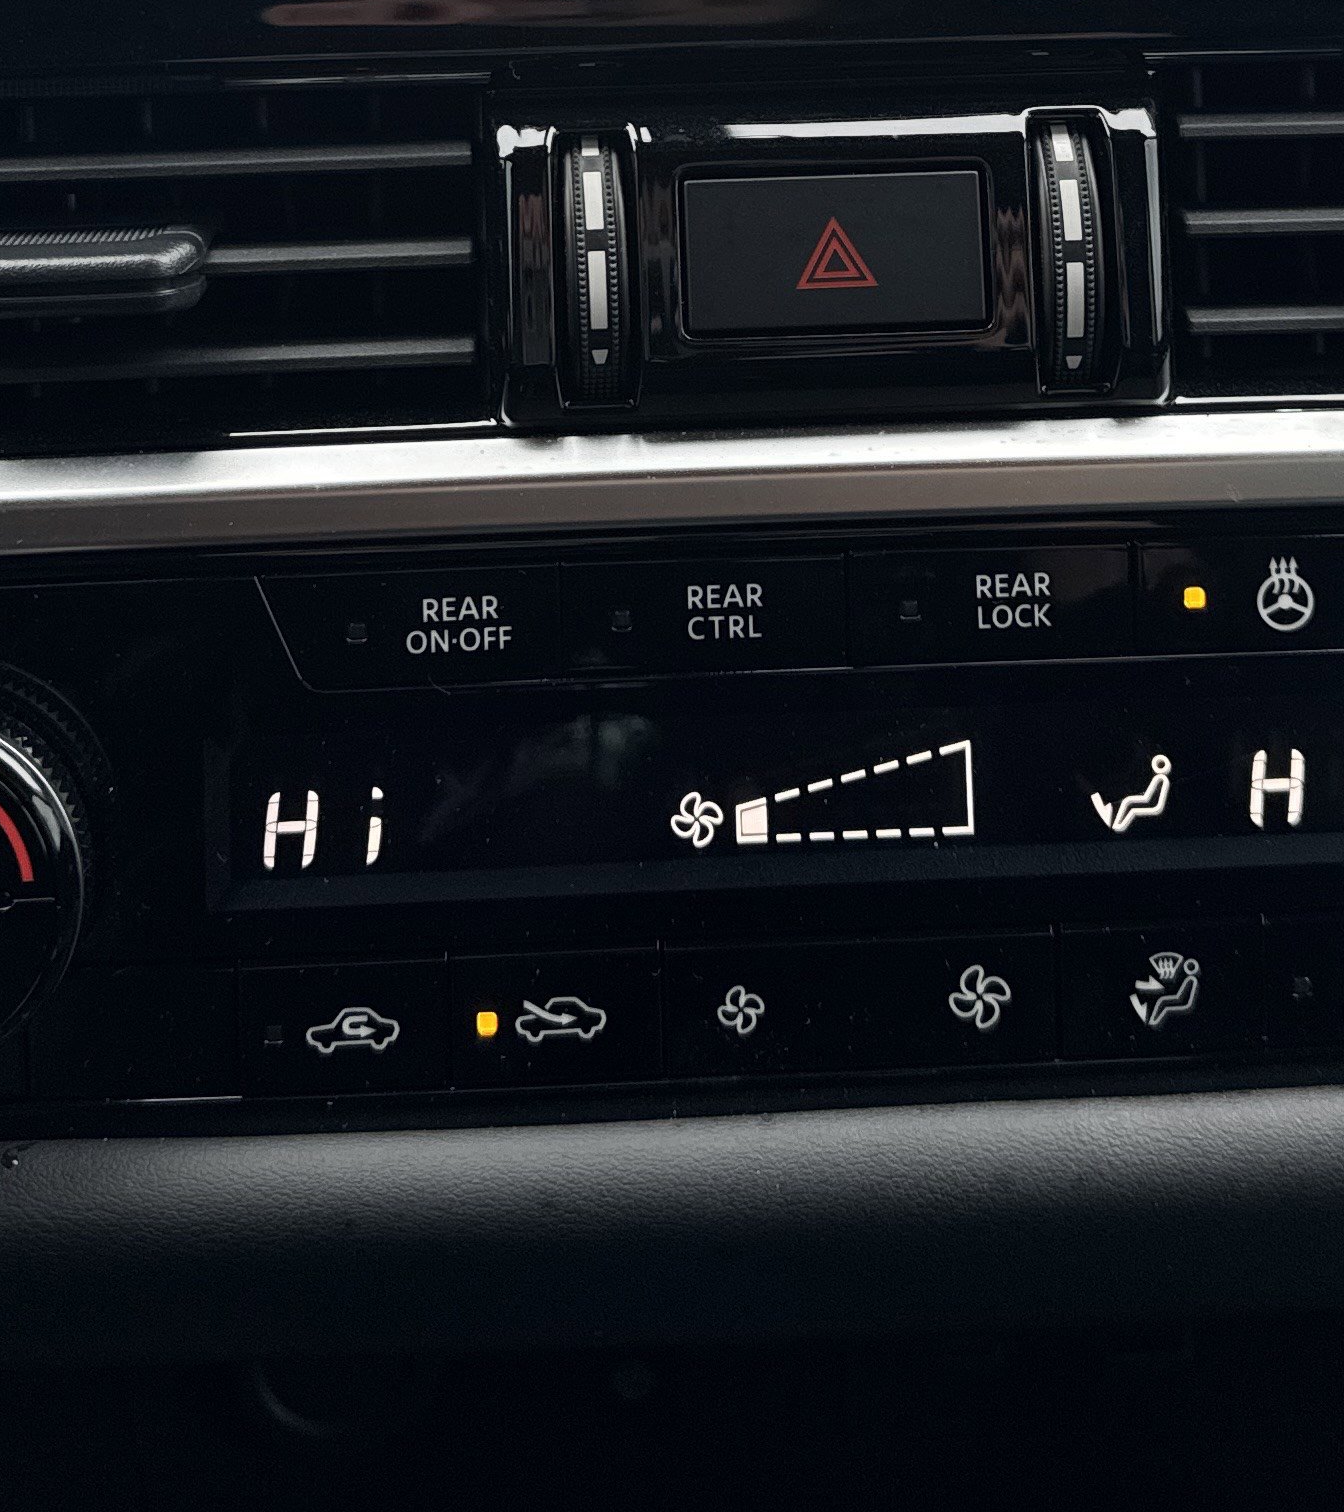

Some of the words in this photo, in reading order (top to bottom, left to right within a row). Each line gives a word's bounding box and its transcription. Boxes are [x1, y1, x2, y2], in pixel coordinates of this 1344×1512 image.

[687, 584, 763, 610] REAR
[976, 573, 1051, 600] REAR
[422, 595, 499, 623] REAR
[977, 603, 1052, 630] LOCK
[687, 615, 762, 640] CTRL
